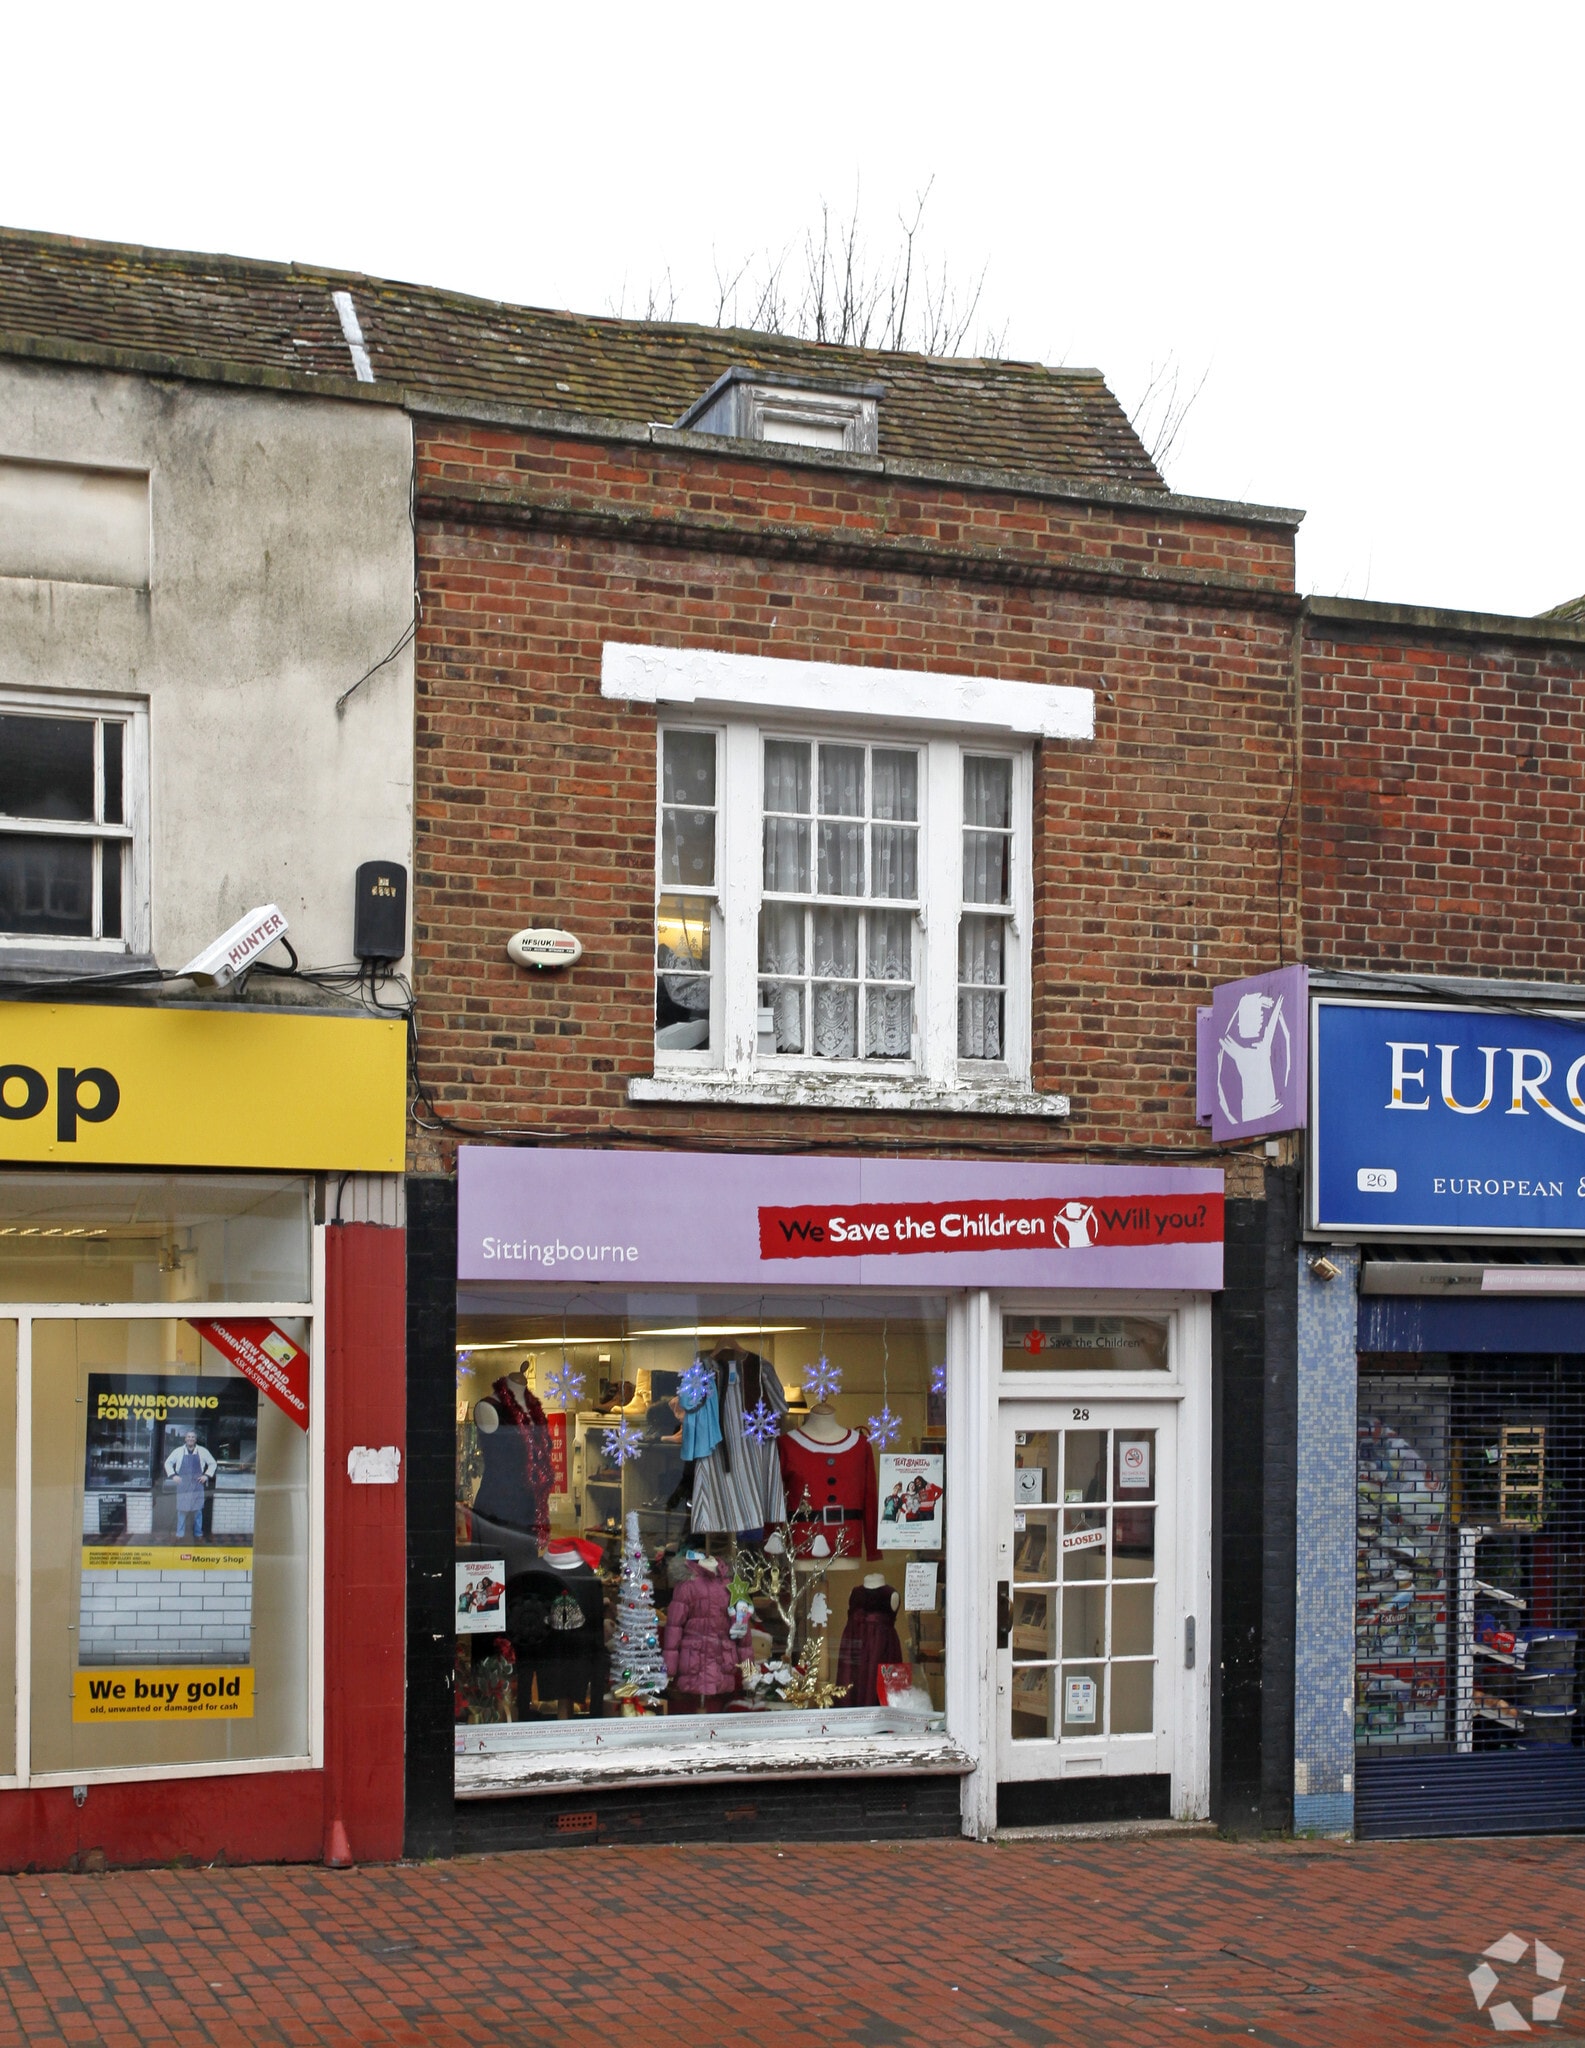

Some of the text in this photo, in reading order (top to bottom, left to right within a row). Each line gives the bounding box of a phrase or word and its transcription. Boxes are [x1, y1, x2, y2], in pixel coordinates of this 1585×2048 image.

[228, 914, 283, 964] HUNTER
[522, 939, 555, 947] NFS(UK)
[1366, 1173, 1387, 1188] 26
[1433, 1178, 1564, 1197] EUROPEAN
[778, 1204, 1207, 1242] We Save the Children Will you?
[482, 1237, 639, 1266] Sittingbourne
[1049, 1336, 1140, 1348] Save the Children
[210, 1321, 305, 1411] MOMENTUM MASTERCARD
[234, 1357, 247, 1370] ASK
[240, 1336, 259, 1356] NEW
[258, 1354, 290, 1385] PREPAID
[97, 1393, 219, 1409] PAWNBROKING
[97, 1407, 167, 1421] FOR YOU
[1072, 1407, 1090, 1421] 28
[1062, 1532, 1103, 1548] CLOSED
[192, 1556, 220, 1564] Money
[223, 1556, 244, 1564] Shop
[89, 1676, 240, 1703] We buy gold
[90, 1705, 106, 1714] old,
[108, 1704, 150, 1713] unwanted
[164, 1704, 203, 1713] damaged
[205, 1703, 217, 1711] for
[220, 1702, 239, 1711] cash
